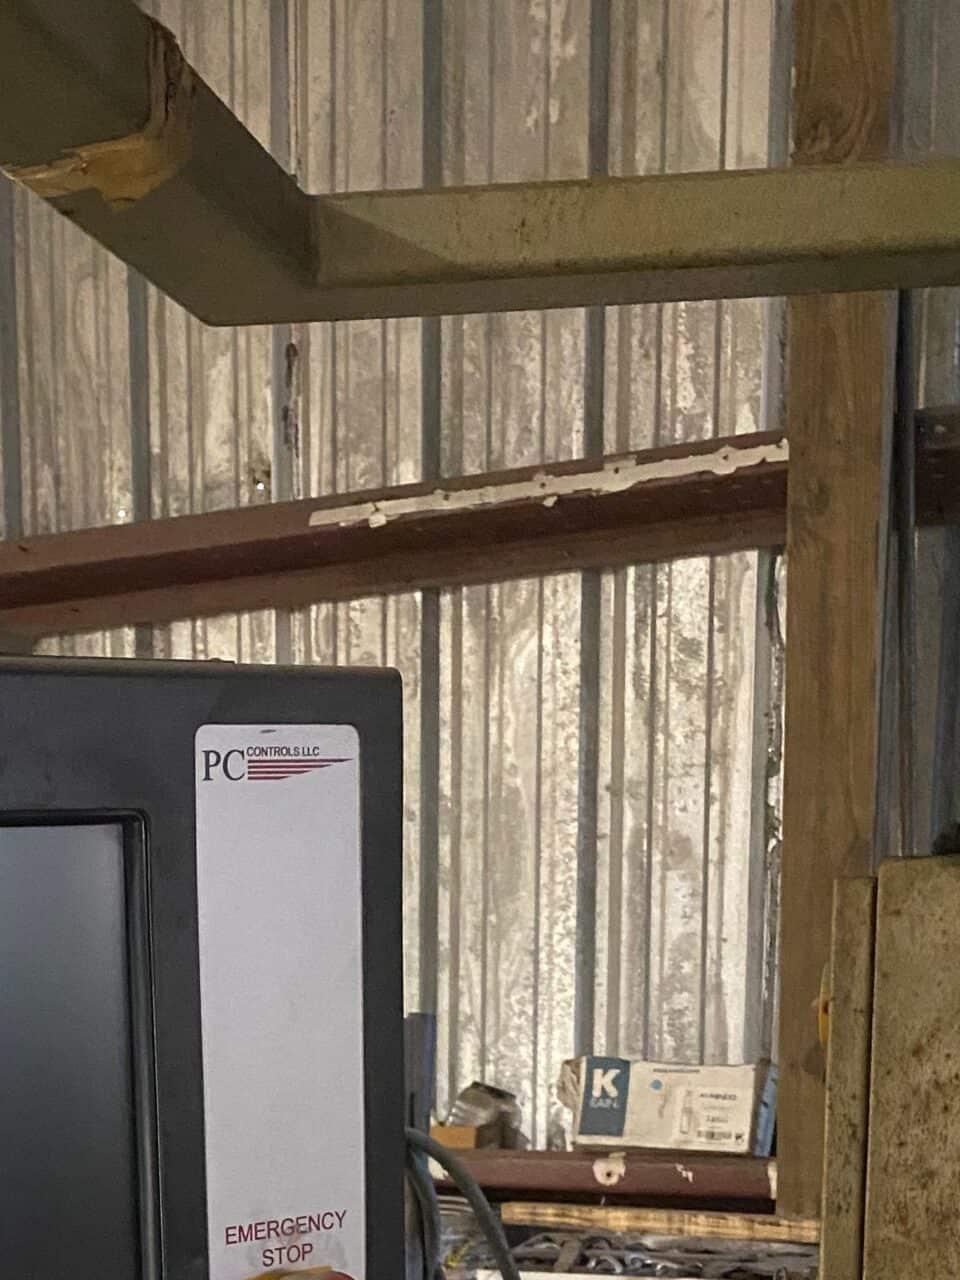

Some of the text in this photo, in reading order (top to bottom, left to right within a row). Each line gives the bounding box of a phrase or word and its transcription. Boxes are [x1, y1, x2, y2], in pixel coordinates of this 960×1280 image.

[202, 745, 320, 781] PC CONTROLS LLC
[592, 1068, 620, 1098] K
[225, 1210, 346, 1245] EMERGENCY
[262, 1243, 313, 1267] STOP
